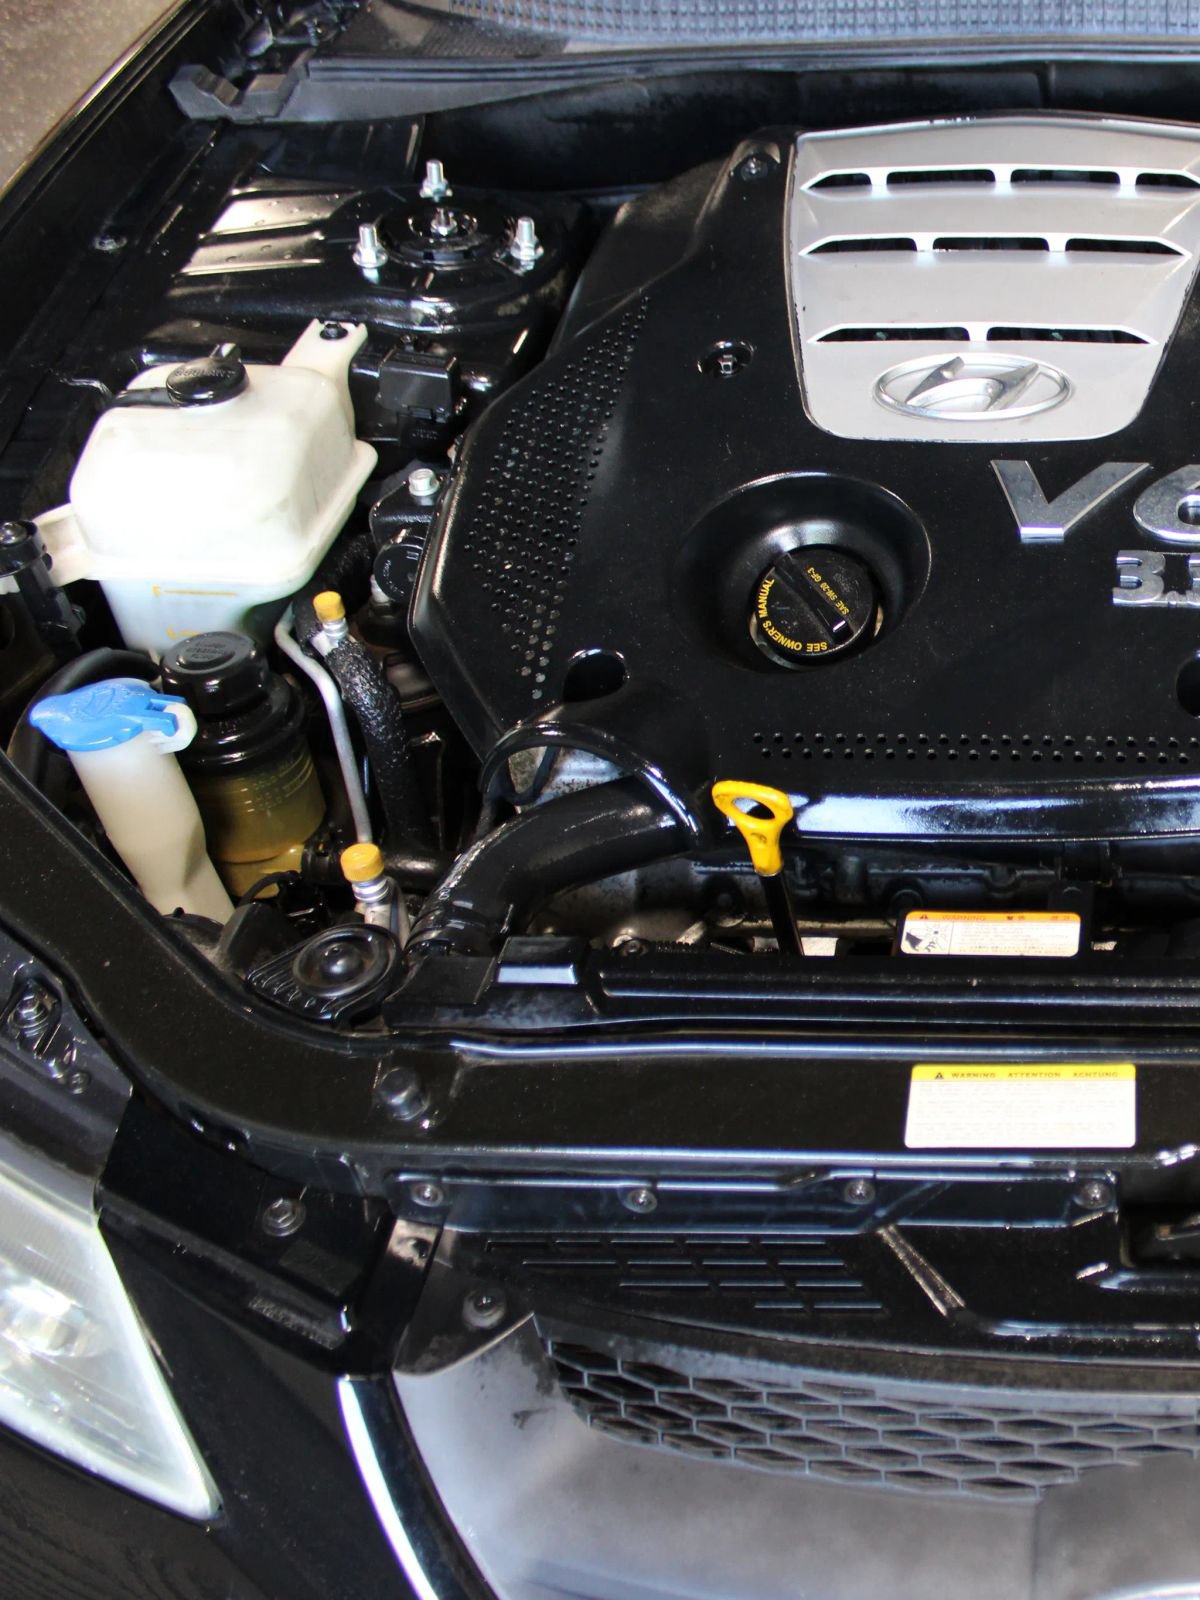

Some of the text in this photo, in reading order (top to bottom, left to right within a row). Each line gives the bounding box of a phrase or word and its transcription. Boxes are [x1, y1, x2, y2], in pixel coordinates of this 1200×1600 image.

[819, 582, 838, 601] 5W-20
[758, 579, 828, 653] SEE OWNER'S MANUAL
[835, 600, 850, 616] SAE
